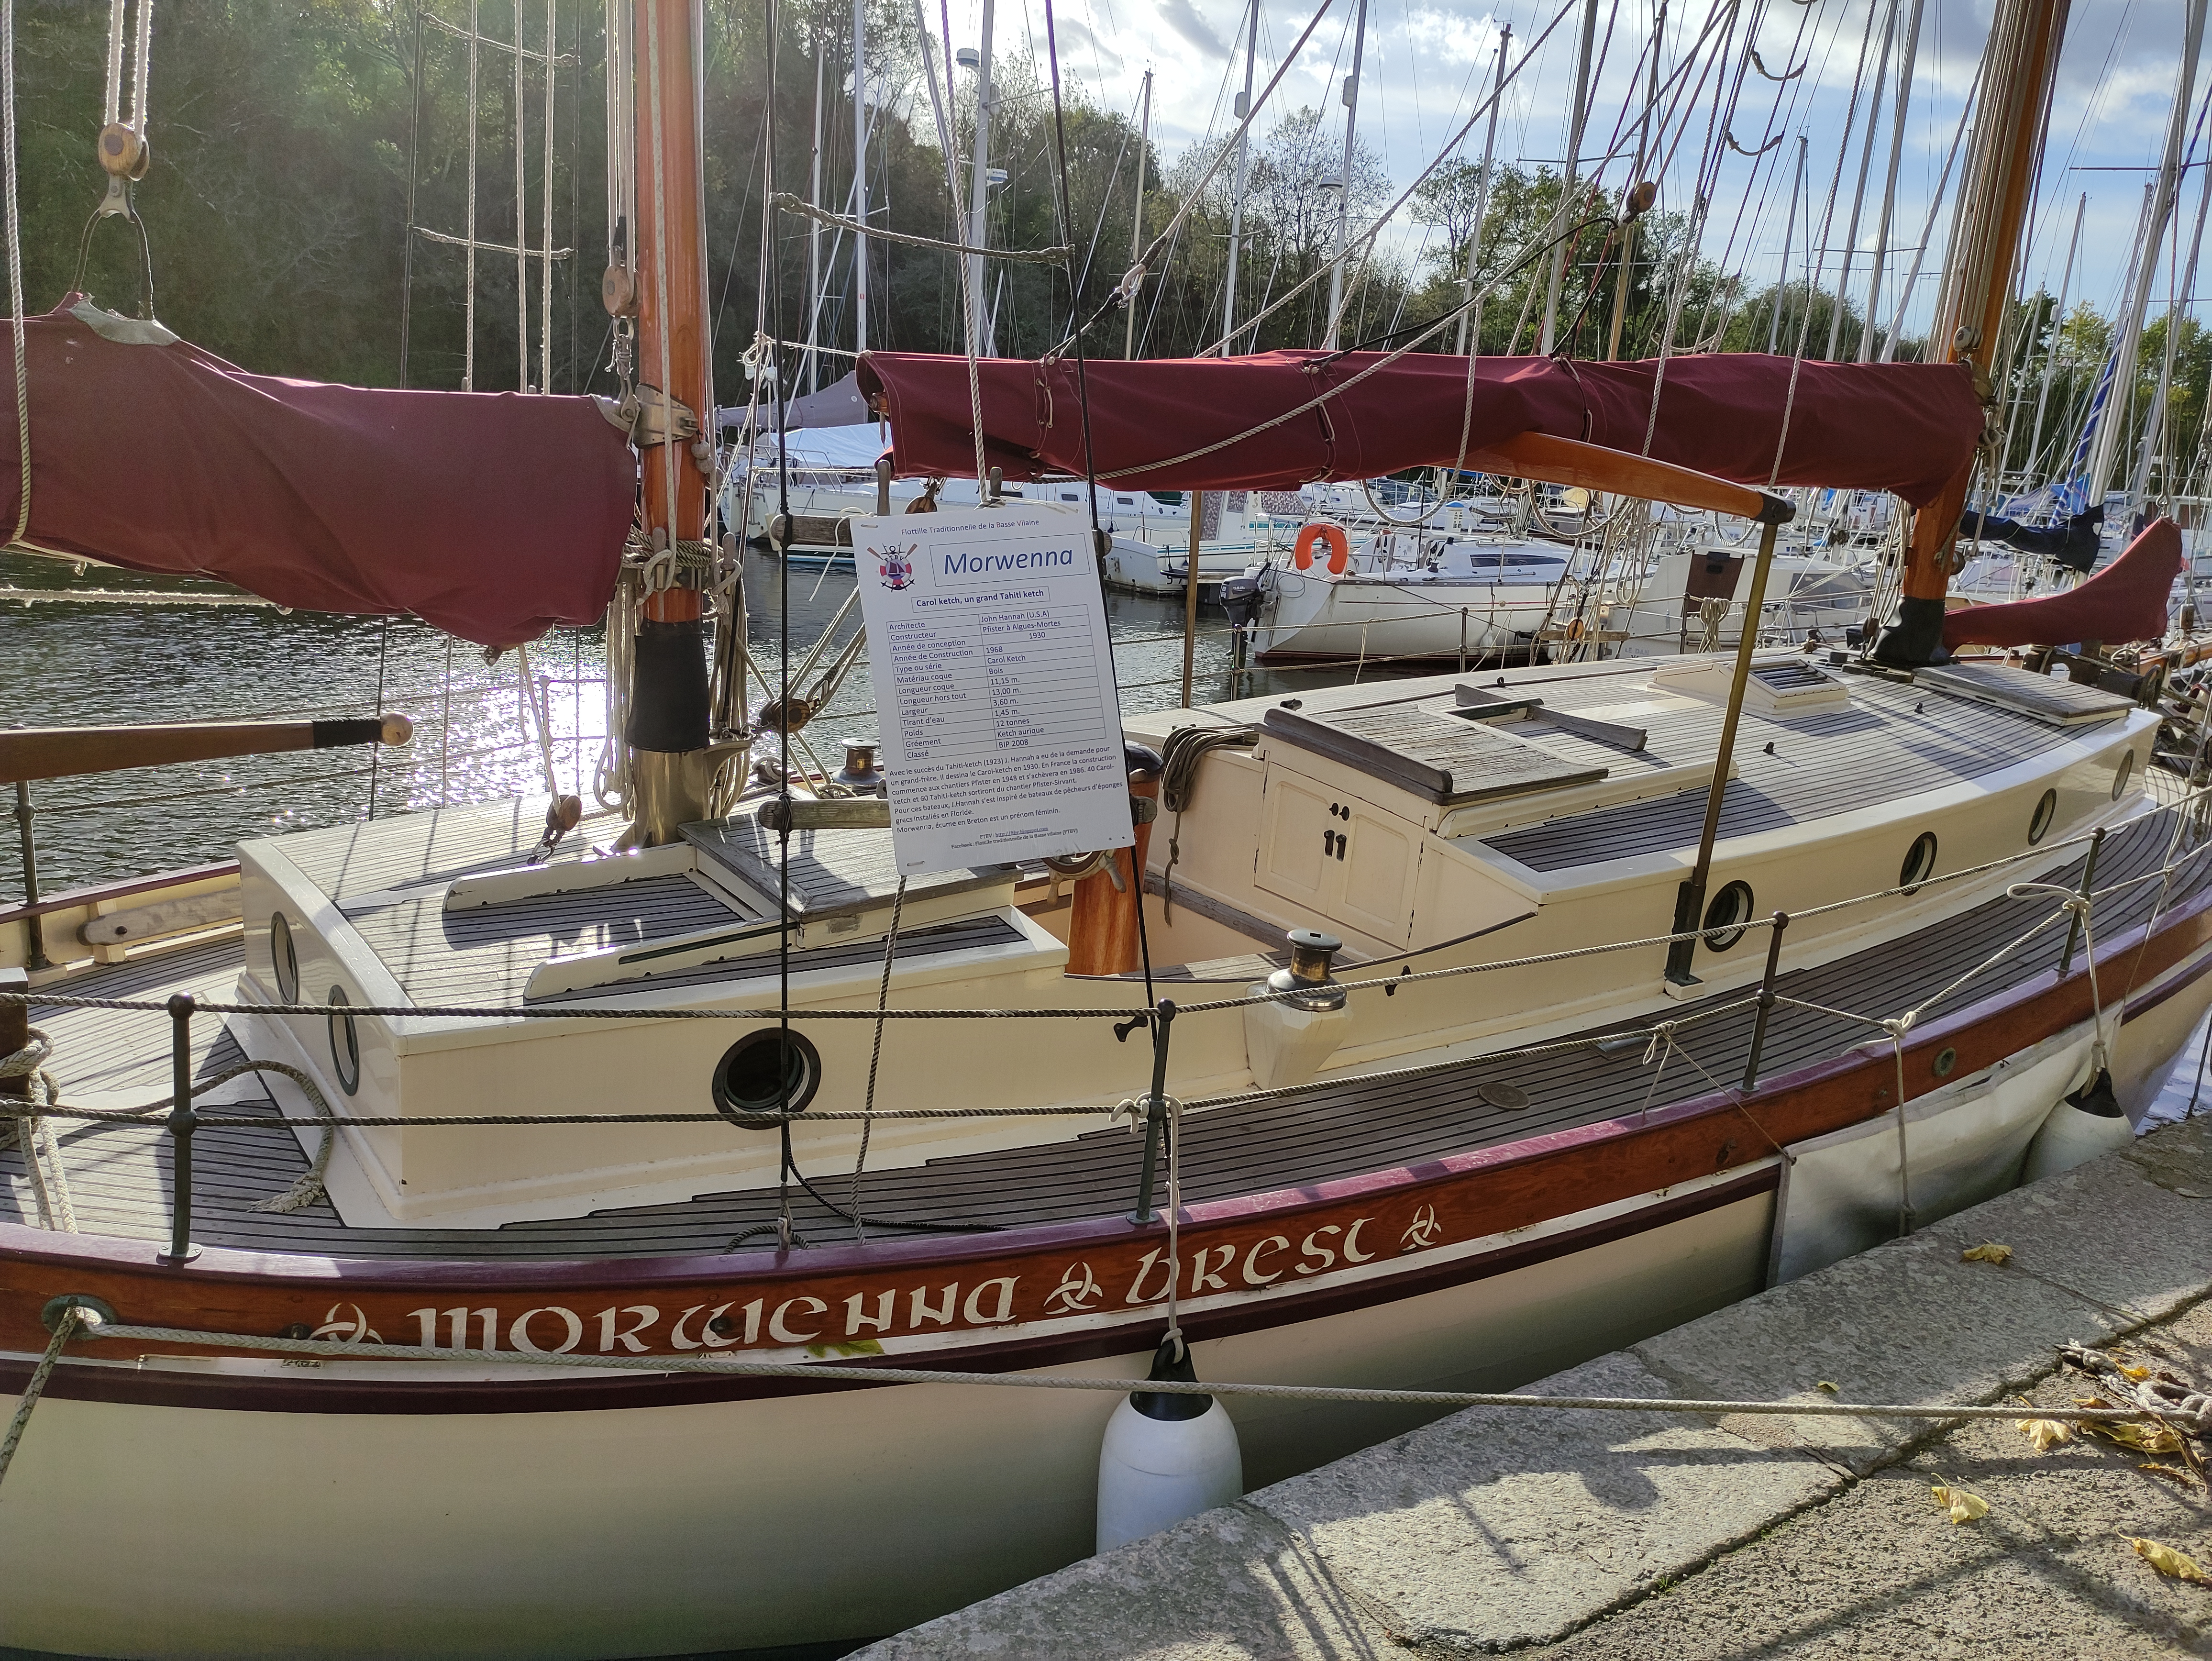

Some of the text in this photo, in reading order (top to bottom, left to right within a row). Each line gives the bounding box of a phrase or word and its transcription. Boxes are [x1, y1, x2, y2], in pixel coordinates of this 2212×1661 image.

[901, 527, 928, 535] Flottille
[929, 523, 976, 533] Traditionnelle
[945, 550, 1072, 575] Morwenna
[916, 598, 937, 607] Carol
[976, 593, 998, 603] grand
[999, 591, 1021, 600] Tahiti
[1023, 589, 1044, 598] ketch
[998, 612, 1025, 621] Hannah
[889, 622, 925, 631] Architecte
[891, 632, 936, 641] Constructeur
[892, 643, 915, 652] Année
[927, 640, 966, 649] conception
[986, 646, 1003, 654] 1968
[894, 654, 917, 662] Année
[929, 649, 973, 659] Construction
[987, 654, 1026, 664] Carol Ketch
[895, 666, 913, 674] Type
[897, 675, 929, 684] Matériau
[898, 686, 932, 695] Longueur
[900, 697, 933, 705] Longueur
[901, 708, 928, 716] Largeur
[902, 718, 924, 726] Tirant
[904, 729, 923, 737] Poids
[997, 729, 1017, 738] Ketch
[906, 738, 941, 748] Gréement
[1011, 739, 1029, 747] 2008
[907, 750, 929, 759] Classé
[914, 766, 935, 774] succès
[1010, 754, 1034, 763] Hannah
[1066, 747, 1095, 756] demande
[945, 772, 969, 780] dessina
[1079, 755, 1116, 764] construction
[892, 787, 927, 796] commence
[941, 782, 970, 790] chantiers
[893, 797, 911, 805] ketch
[968, 787, 995, 796] sortiront
[1006, 783, 1031, 791] chantier
[996, 793, 1018, 802] inspiré
[1063, 786, 1091, 795] pêcheurs
[896, 817, 913, 825] grecs
[914, 812, 940, 821] installés
[1010, 812, 1034, 820] prénom
